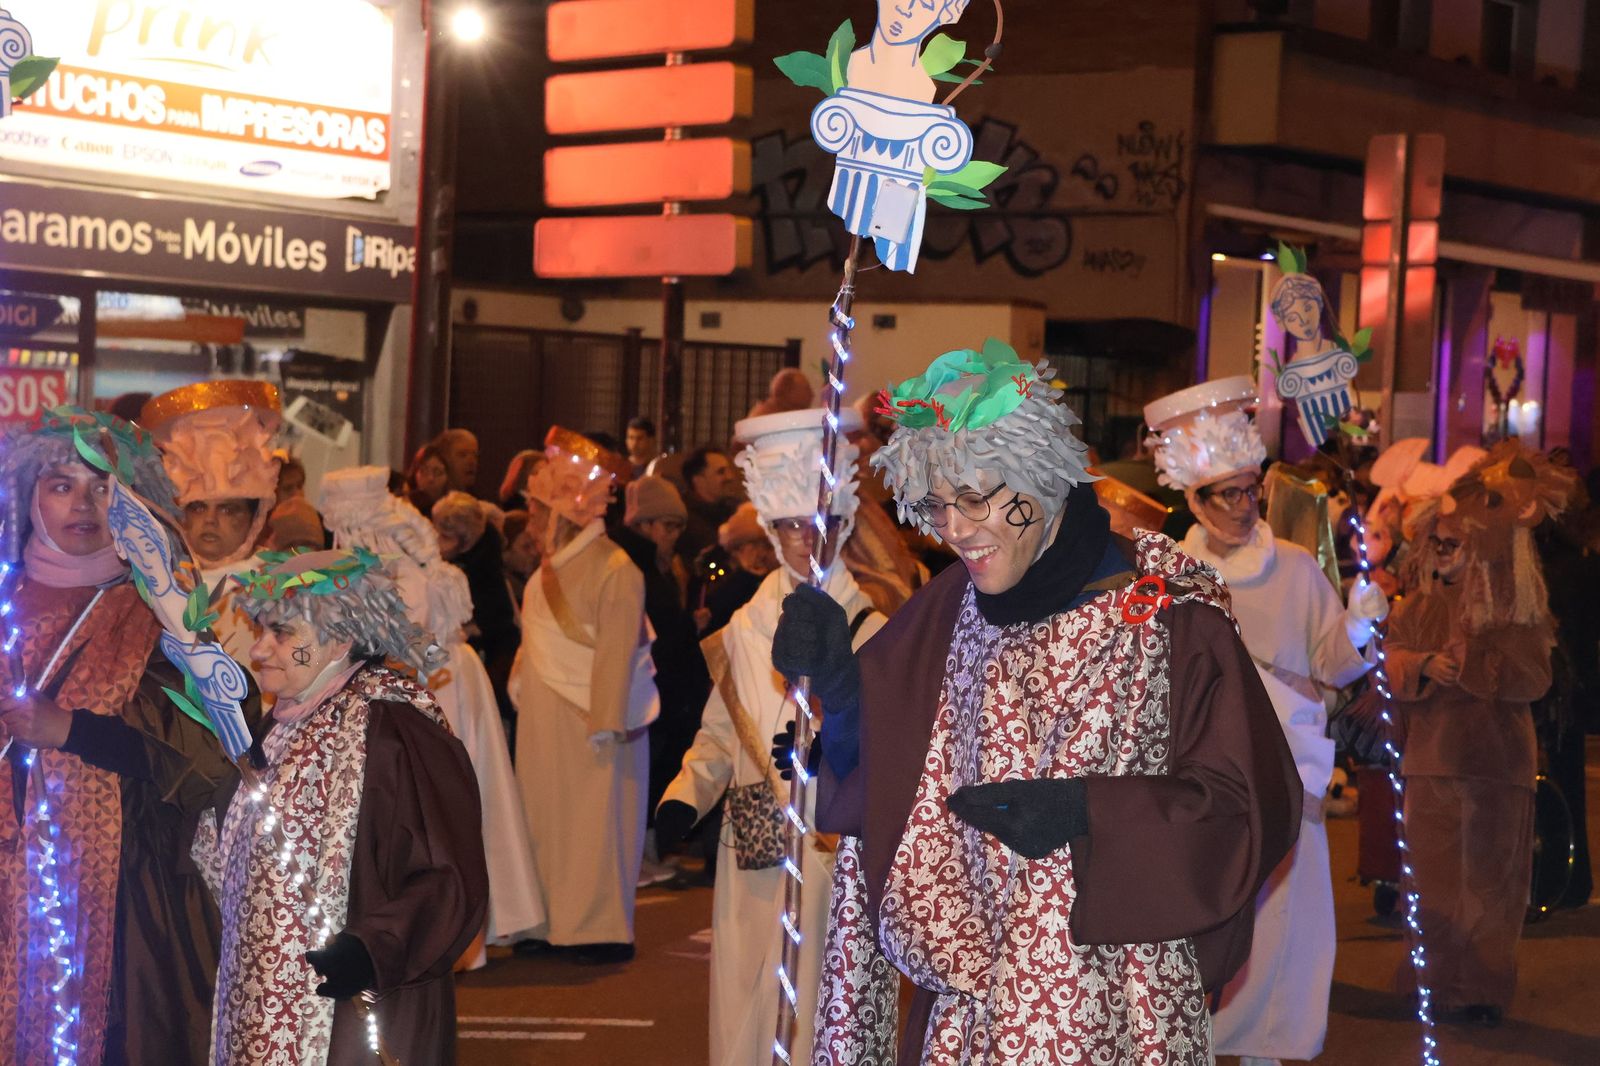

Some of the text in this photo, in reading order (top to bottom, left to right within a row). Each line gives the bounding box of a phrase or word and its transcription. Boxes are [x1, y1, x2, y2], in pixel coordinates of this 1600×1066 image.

[61, 136, 114, 156] Canon
[123, 143, 173, 164] EPSON
[167, 108, 200, 129] PARA
[200, 93, 386, 155] IMPRESORAS
[0, 208, 153, 255] aramos
[184, 218, 327, 272] Móviles
